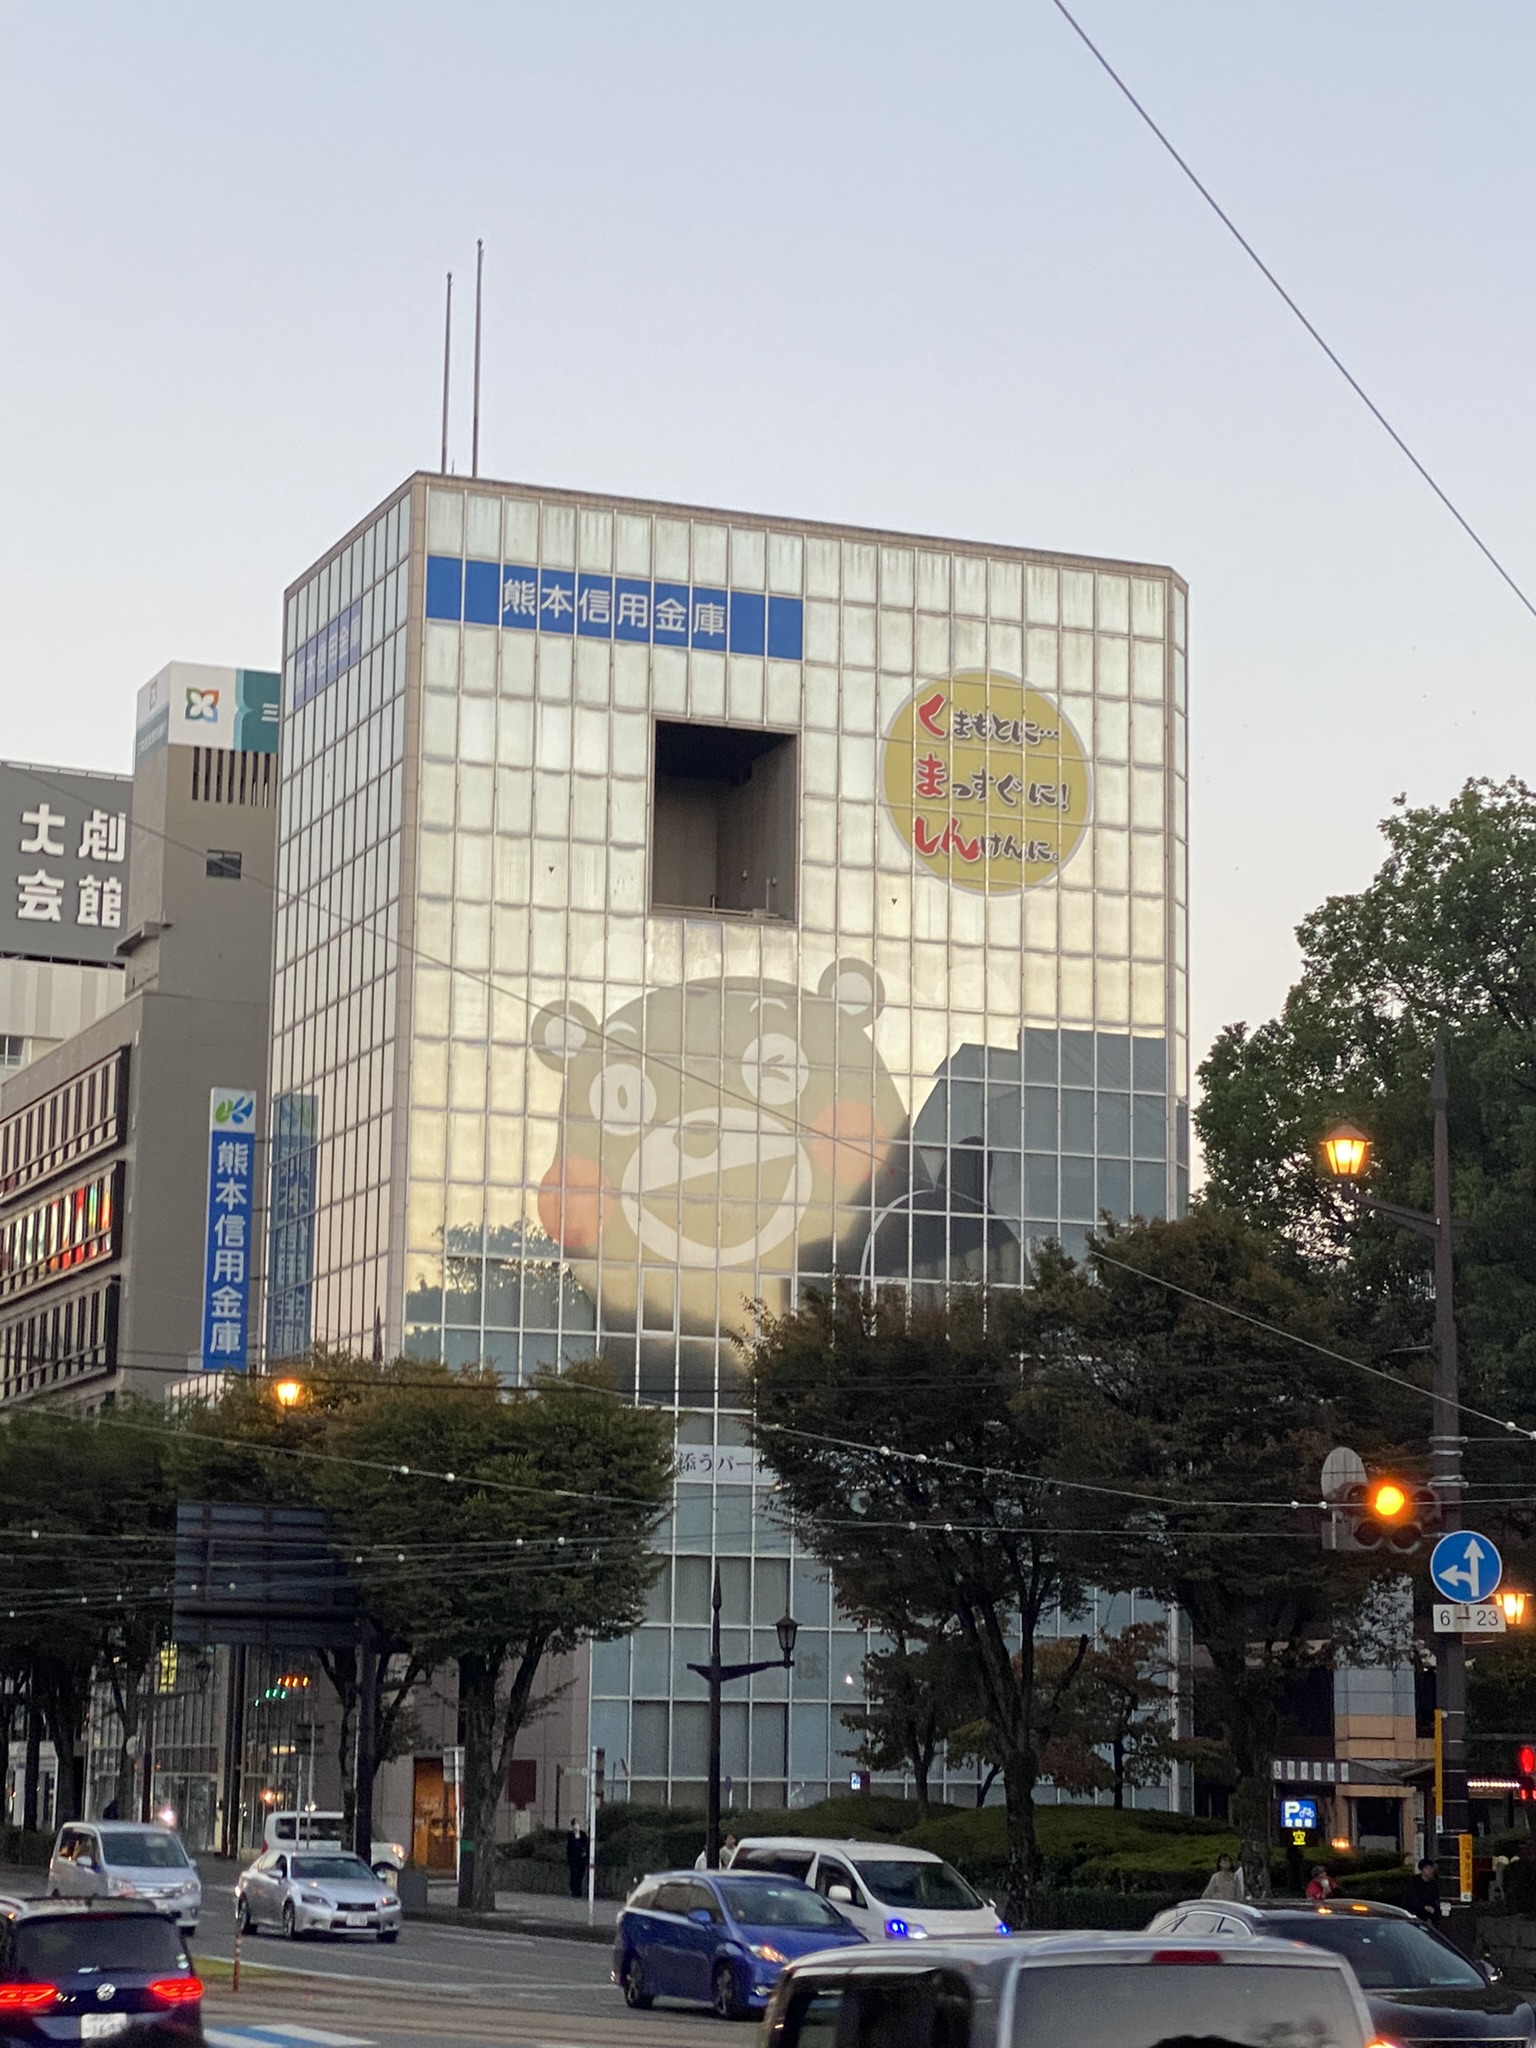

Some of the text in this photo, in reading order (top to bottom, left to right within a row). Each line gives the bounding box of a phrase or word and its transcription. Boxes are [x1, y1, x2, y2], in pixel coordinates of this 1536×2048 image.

[503, 579, 726, 637] 熊本信用金庫
[20, 803, 126, 862] 大劇
[17, 869, 122, 928] 会館
[210, 1141, 249, 1355] 熊本信用金庫
[1284, 1801, 1300, 1819] P
